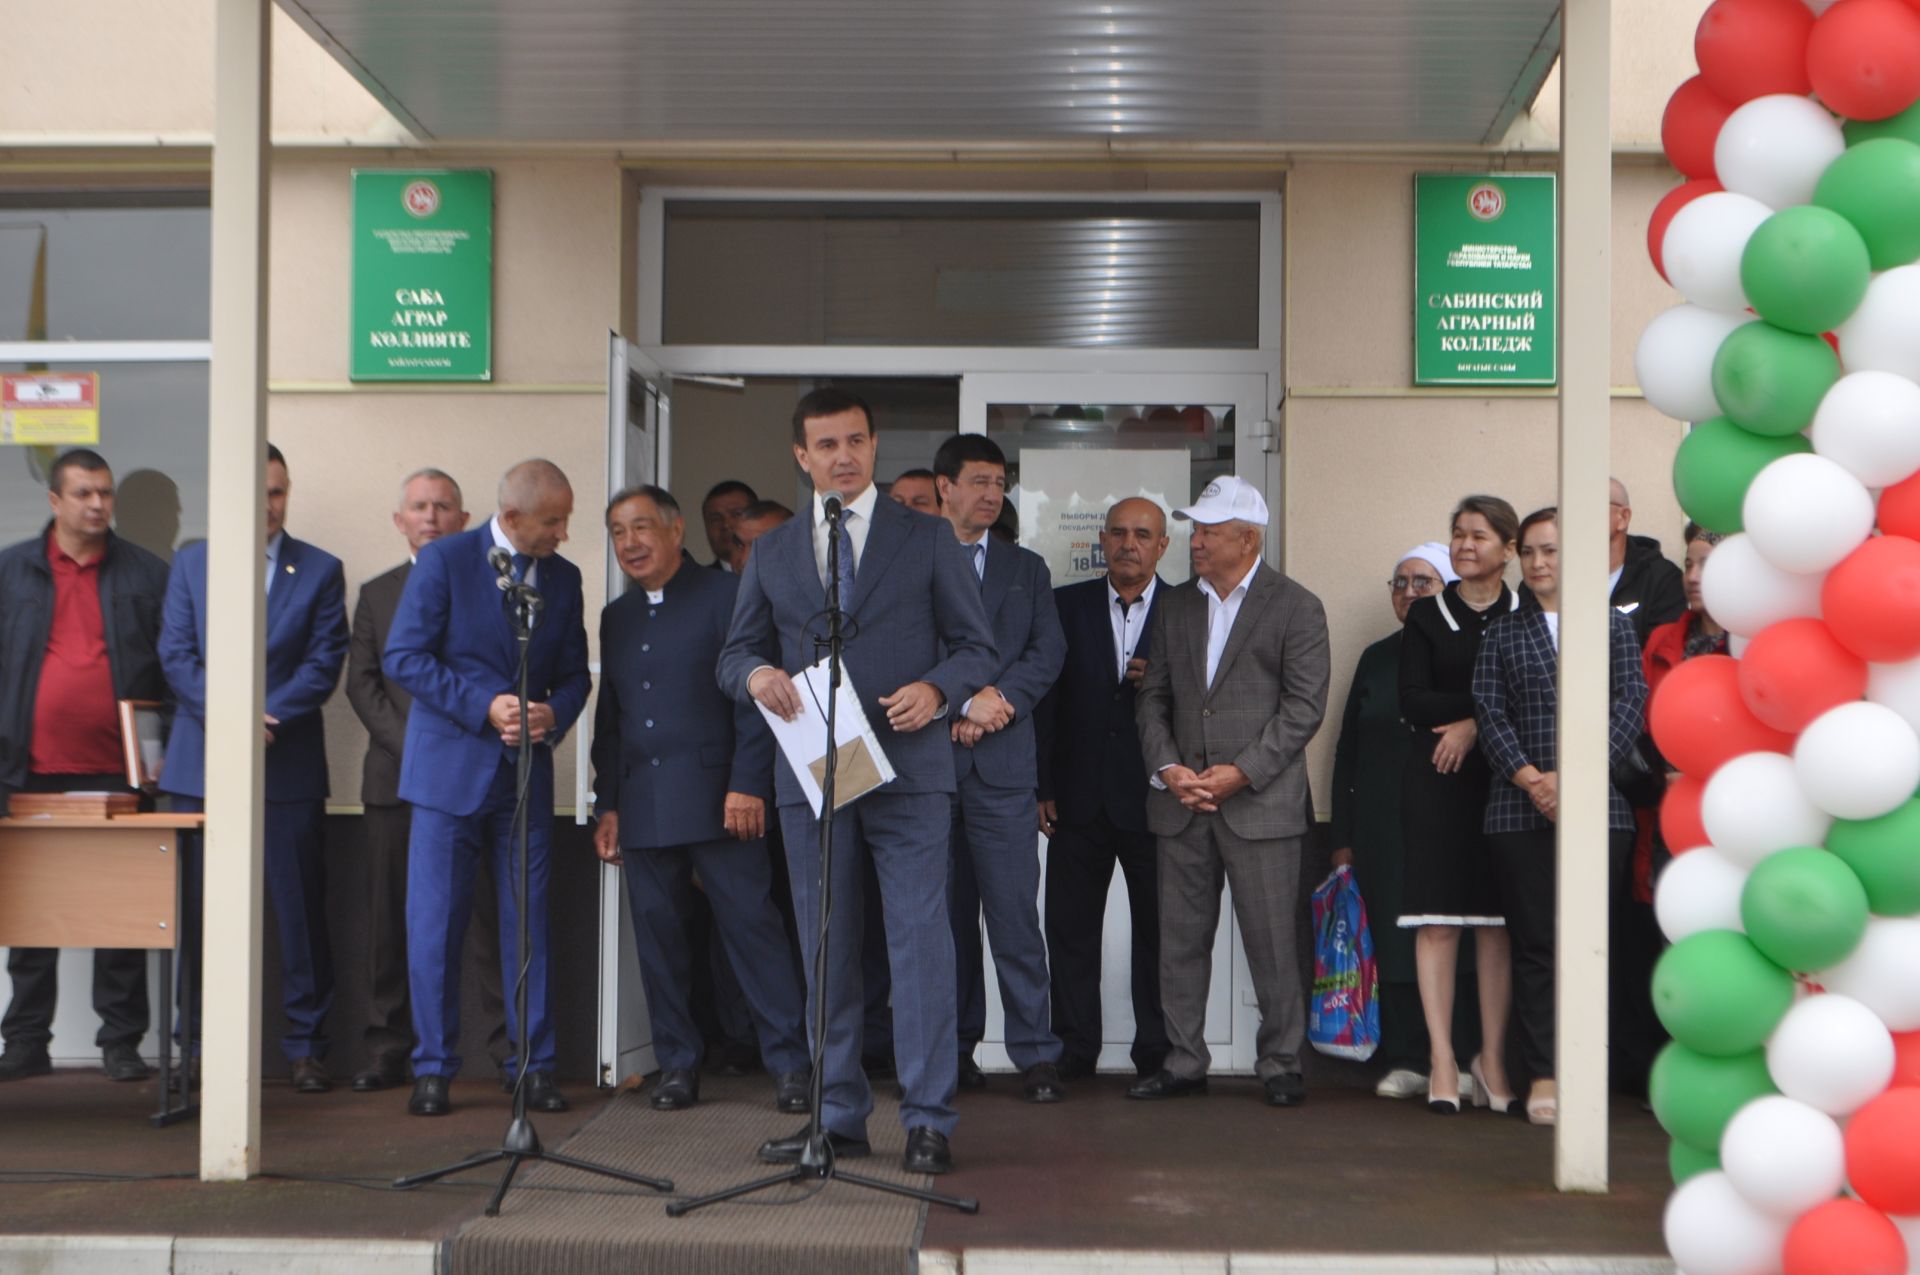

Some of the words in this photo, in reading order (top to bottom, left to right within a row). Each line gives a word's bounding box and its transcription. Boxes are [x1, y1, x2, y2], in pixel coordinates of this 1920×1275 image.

[1428, 290, 1543, 309] САБИНСКИЙ
[391, 310, 448, 327] АГРАР
[1437, 312, 1535, 330] АГРАРНЫЙ
[1441, 336, 1533, 353] КОЛЛЕДЖ
[1072, 557, 1090, 571] 18
